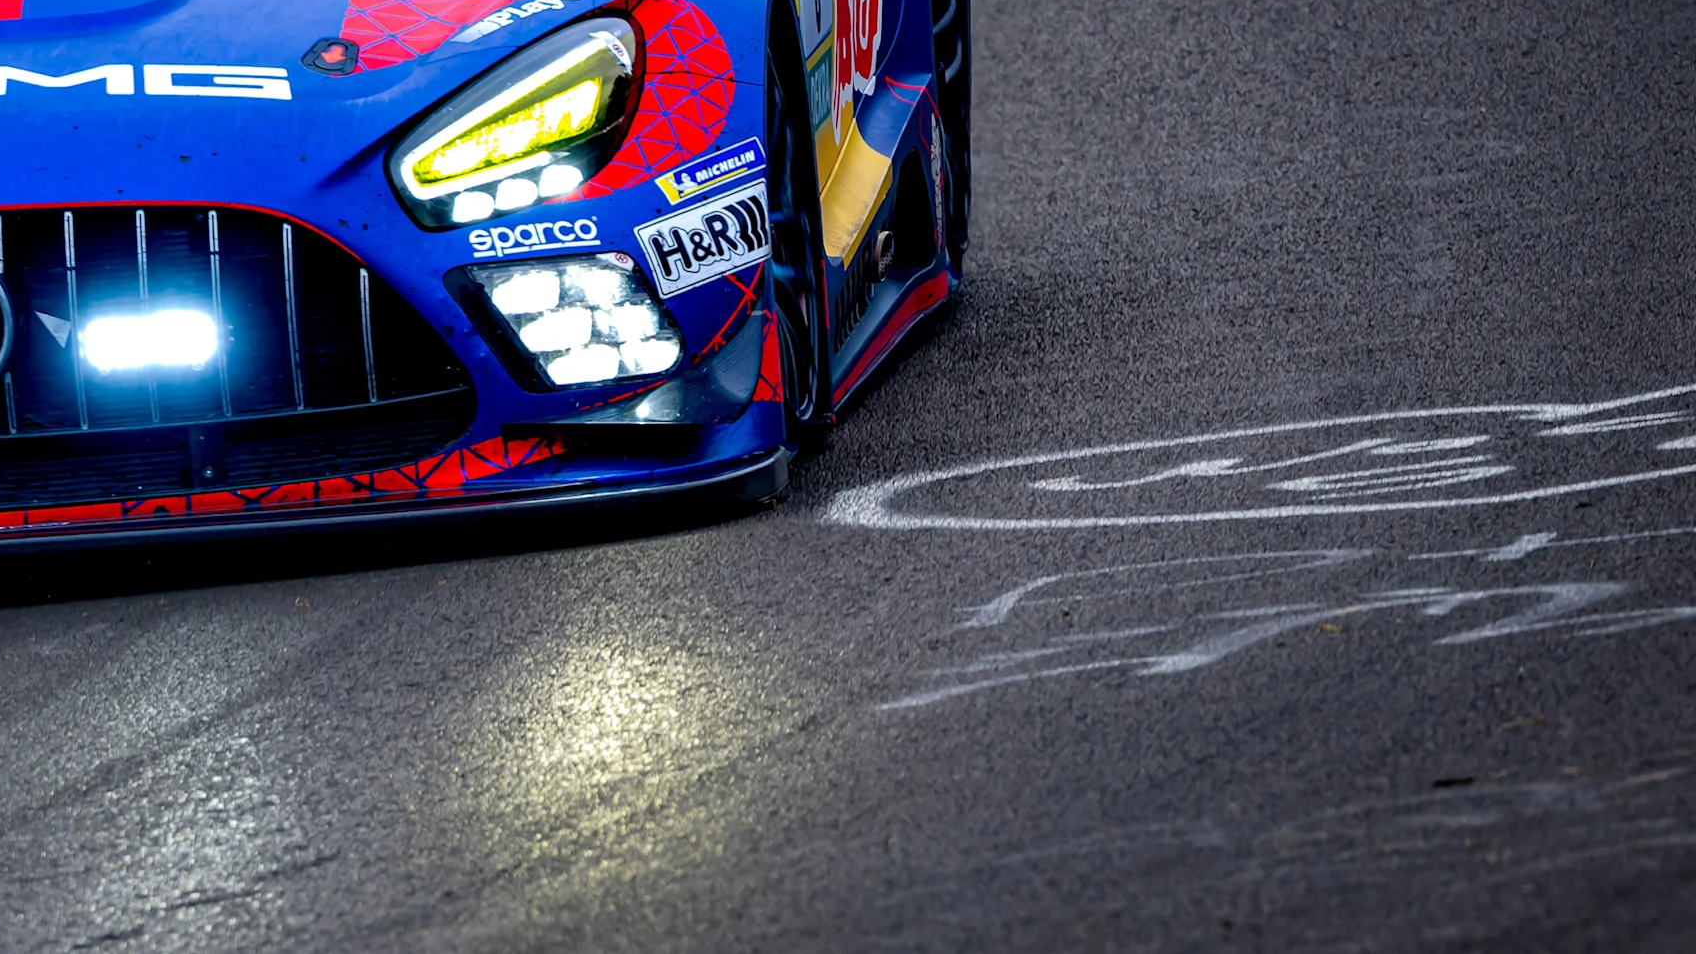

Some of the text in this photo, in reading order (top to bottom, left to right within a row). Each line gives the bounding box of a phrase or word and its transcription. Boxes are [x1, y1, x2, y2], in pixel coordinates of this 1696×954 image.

[810, 57, 831, 125] DEKRA
[695, 150, 757, 183] MICHELIN
[468, 218, 598, 259] sparco
[651, 210, 730, 279] H&R
